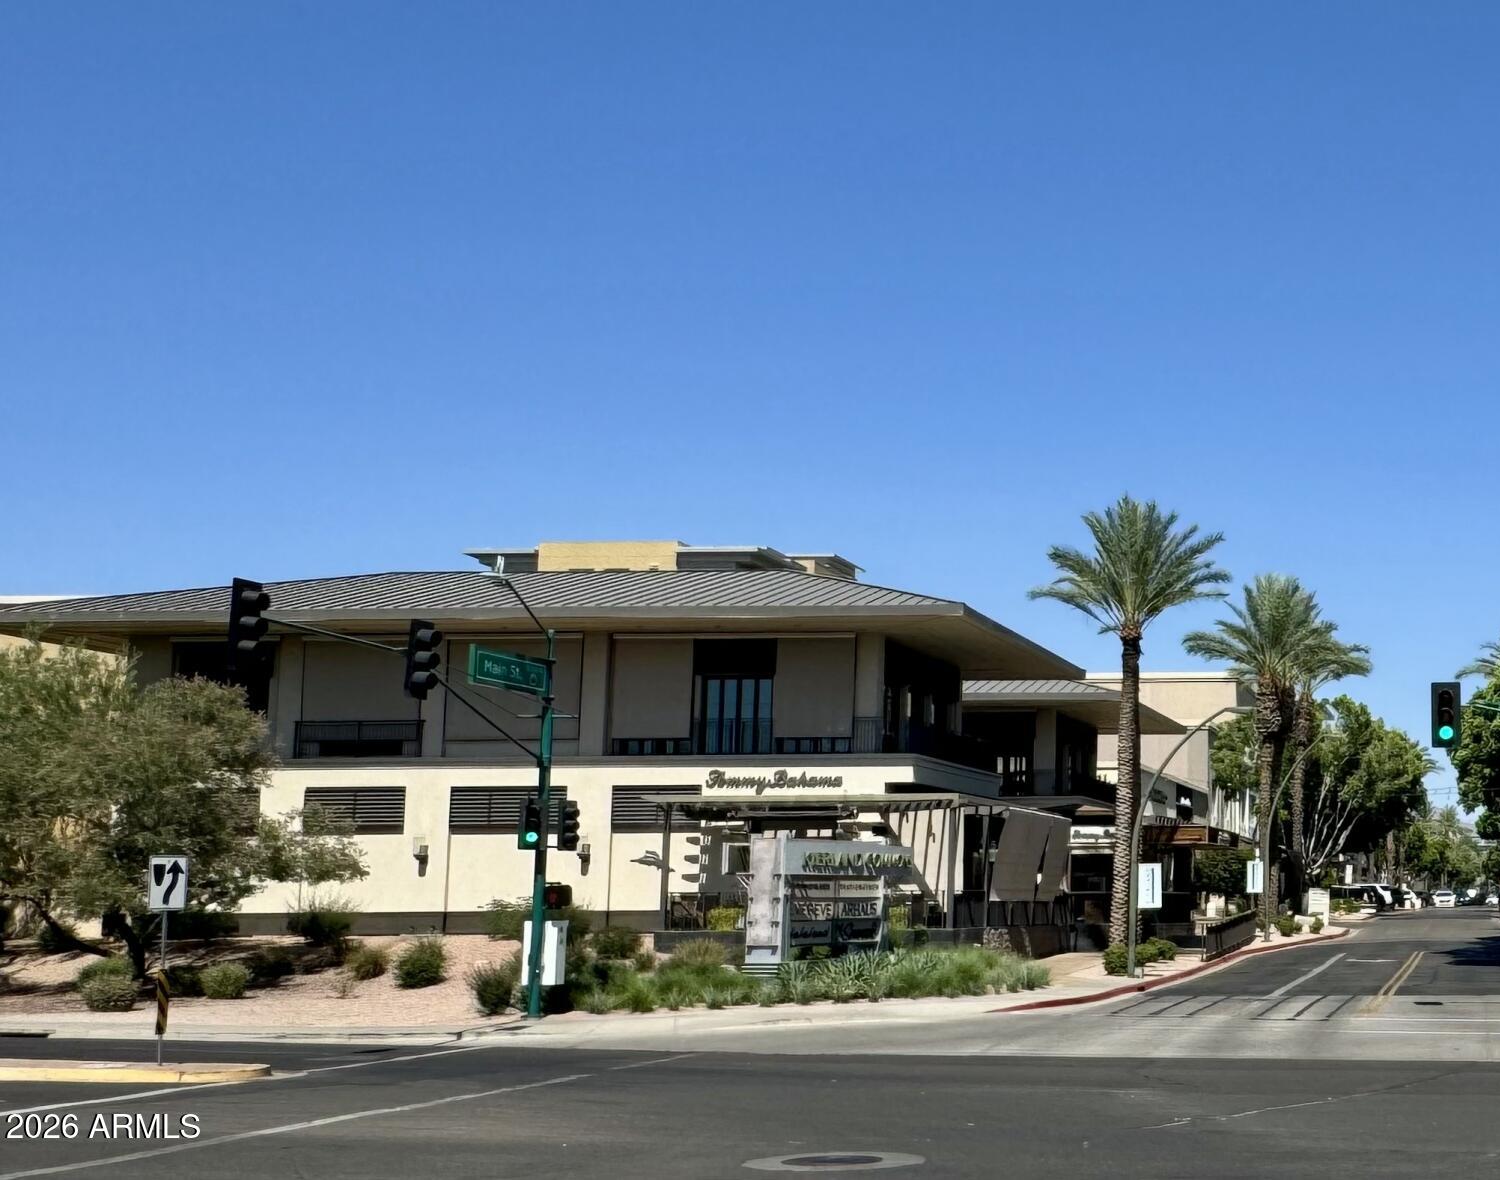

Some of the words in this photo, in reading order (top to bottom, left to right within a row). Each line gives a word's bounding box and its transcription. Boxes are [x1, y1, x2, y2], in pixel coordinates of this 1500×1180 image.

[484, 659, 507, 675] Main
[705, 769, 767, 796] Tommy
[767, 769, 843, 789] Bahama
